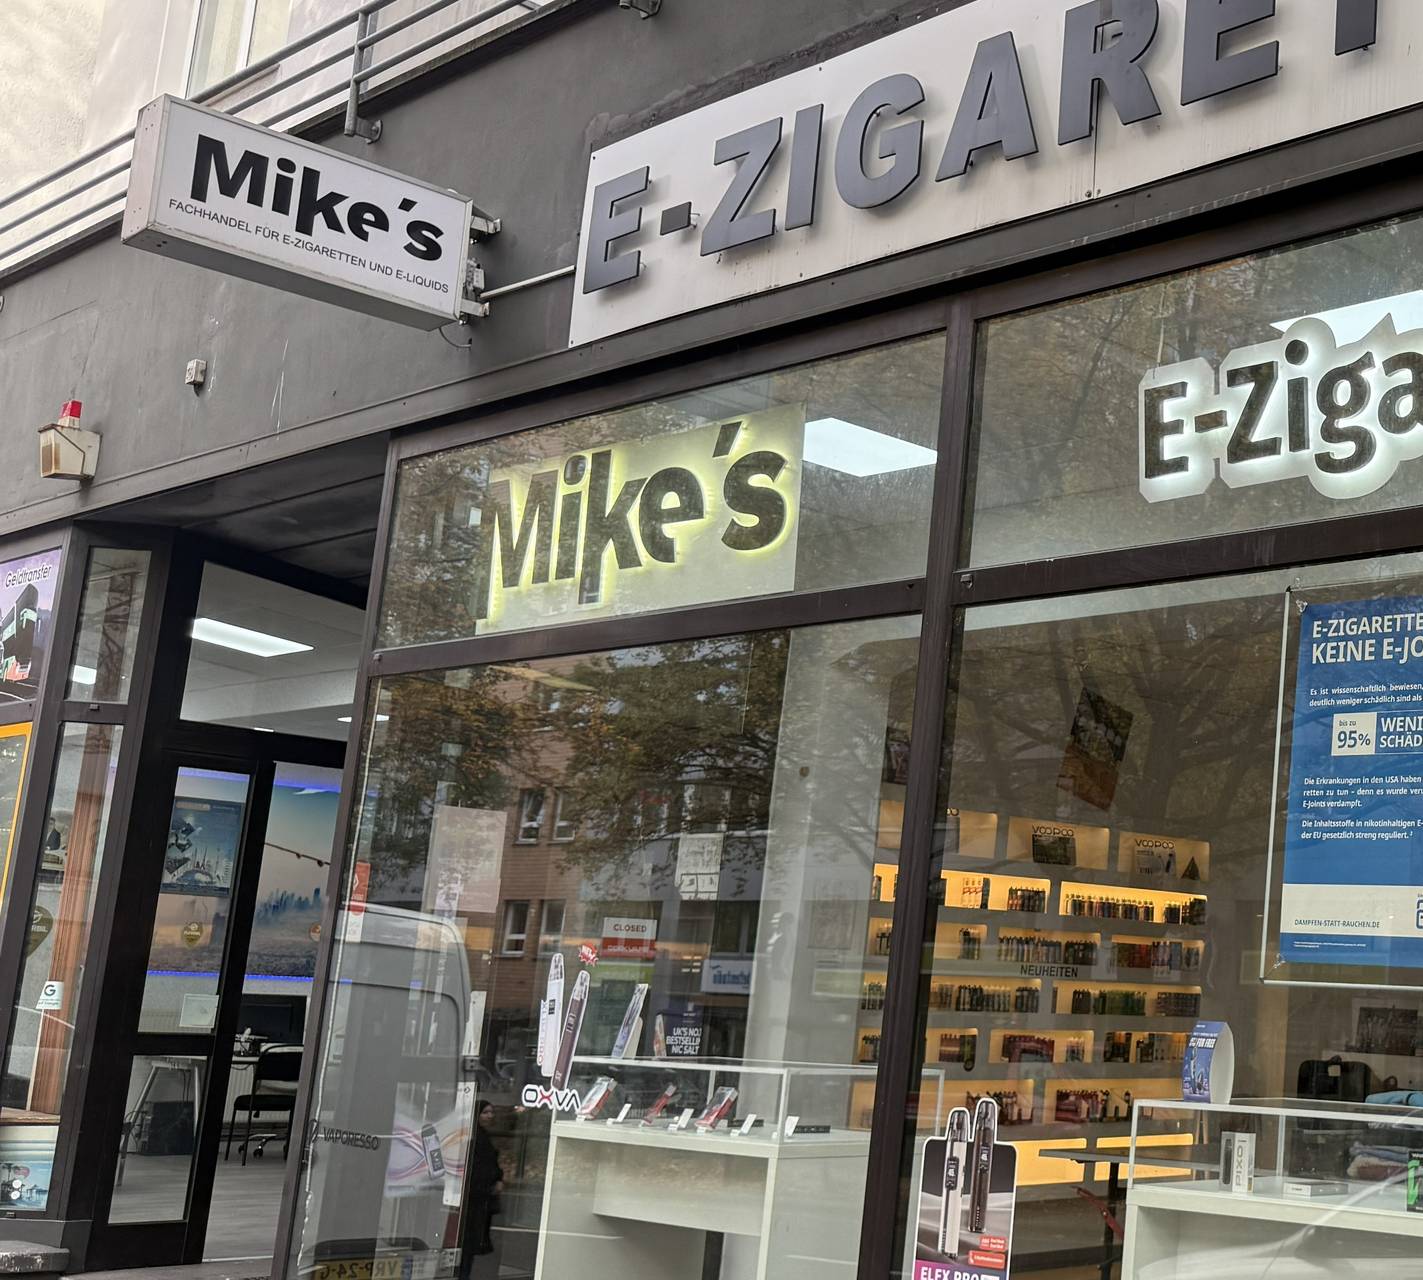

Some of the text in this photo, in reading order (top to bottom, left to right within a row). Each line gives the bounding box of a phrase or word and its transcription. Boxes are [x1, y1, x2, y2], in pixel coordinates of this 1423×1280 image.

[190, 133, 445, 262] Mike's
[168, 198, 449, 294] FACHHANDEL FÜR E-ZIGARETTEN UND E-LIQUIDS
[489, 420, 787, 606] Mike's
[6, 564, 51, 587] Geldtransfer
[1312, 639, 1375, 664] KEINE
[1310, 688, 1317, 696] Es
[1320, 687, 1329, 695] ist
[1331, 683, 1386, 695] wissenschaftlich
[1389, 682, 1423, 692] bewiesen,
[1309, 697, 1335, 707] deutlich
[1336, 696, 1363, 708] weniger
[1363, 694, 1395, 704] schädlich
[1396, 693, 1411, 703] sind
[1411, 693, 1422, 702] als
[1339, 719, 1348, 727] bis
[1337, 730, 1371, 749] 95%
[1316, 776, 1361, 787] Erkrankungen
[1362, 776, 1370, 784] in
[1370, 775, 1384, 783] den
[1385, 775, 1399, 783] USA
[1400, 774, 1422, 783] haben
[1303, 788, 1324, 796] retten
[1337, 788, 1349, 796] tun
[1357, 787, 1374, 796] denn
[1376, 788, 1384, 796] es
[1386, 786, 1408, 795] wurde
[1303, 799, 1363, 809] E-Joints verdampft.
[1302, 819, 1313, 828] Die
[1314, 819, 1355, 828] Inhaltsstoffe
[1355, 819, 1363, 827] in
[1363, 819, 1416, 829] nikotinhaltigen
[1301, 831, 1312, 839] der
[1313, 831, 1322, 839] EU
[1322, 831, 1355, 840] gesetzlich
[1355, 831, 1377, 840] streng
[613, 923, 647, 933] CLOSED
[1294, 919, 1380, 928] DAMPFEN-STATT-RAUCHEN.DE
[1020, 964, 1078, 978] NEUHEITEN
[522, 1086, 582, 1111] OXVA
